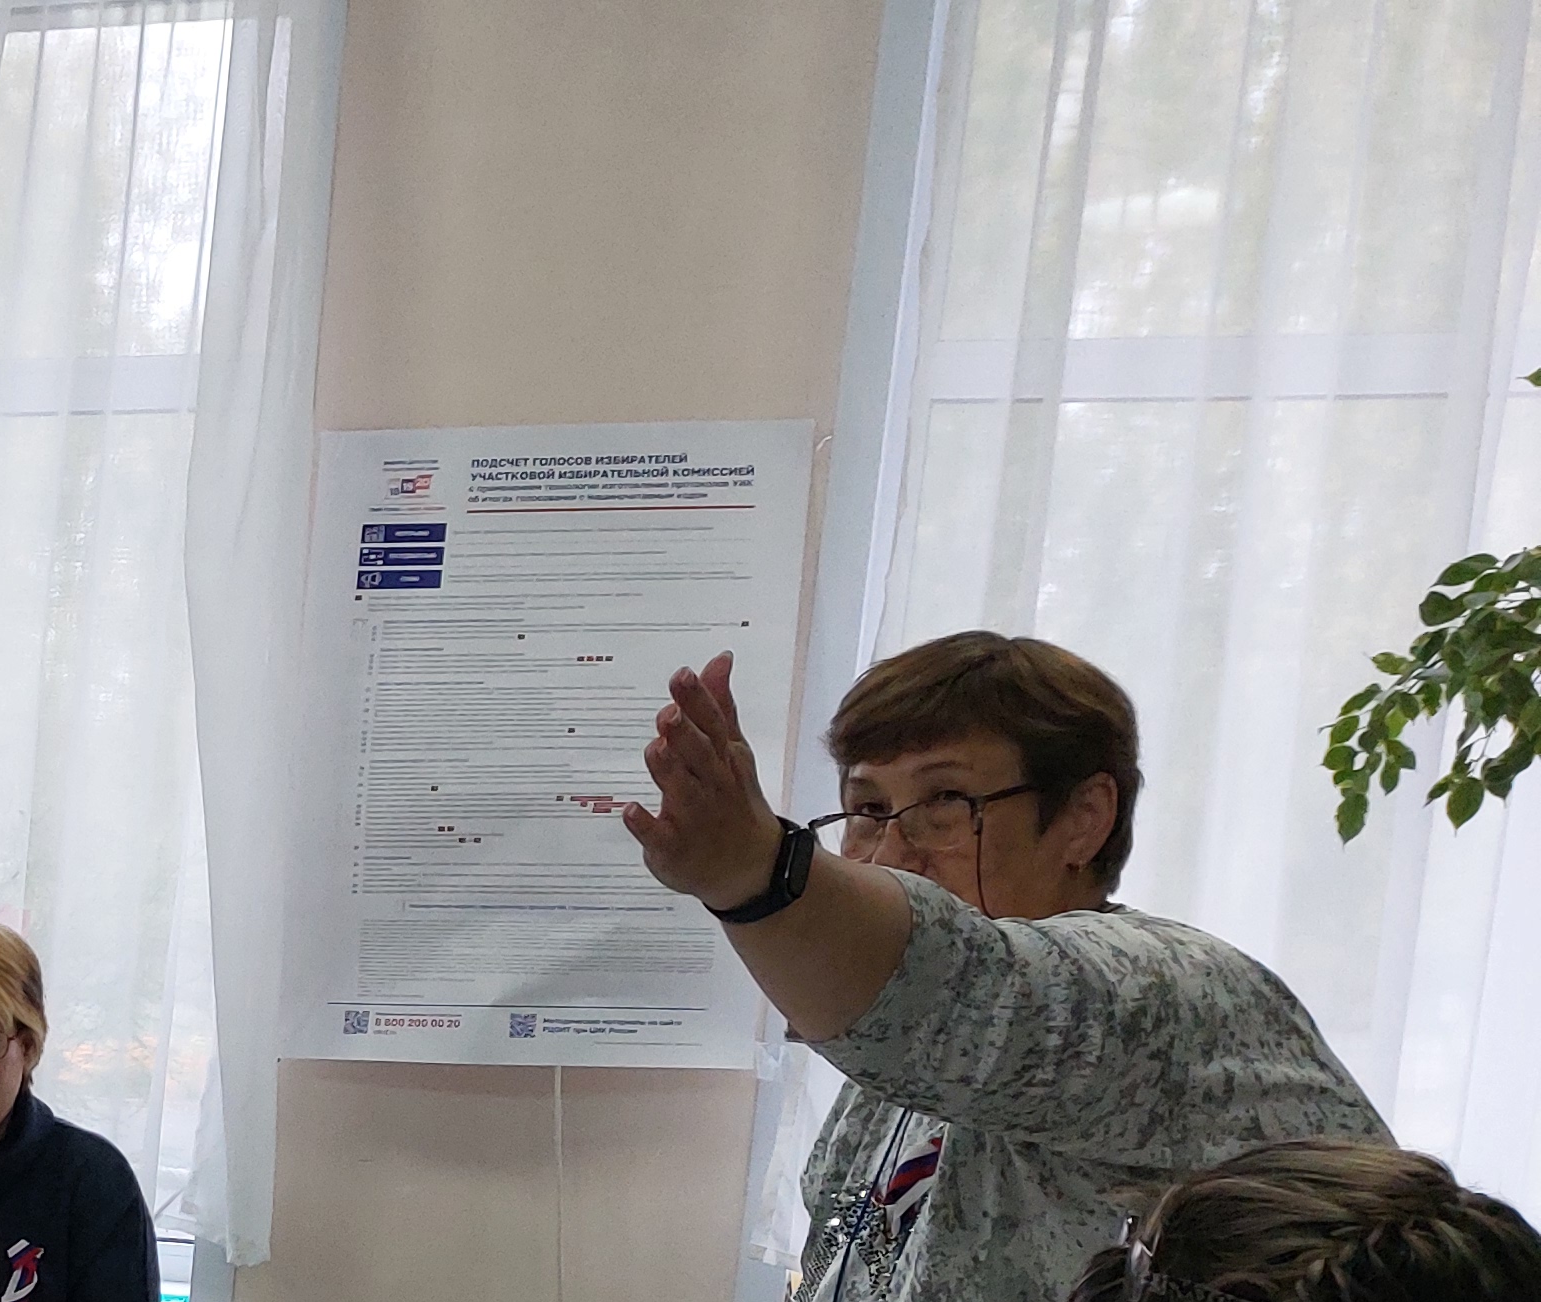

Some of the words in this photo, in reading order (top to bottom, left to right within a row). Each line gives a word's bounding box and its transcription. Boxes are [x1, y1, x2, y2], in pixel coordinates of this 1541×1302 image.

[471, 457, 530, 469] ПОДСЧЕТ
[532, 456, 592, 467] ГОЛОСОВ
[595, 452, 688, 465] ИЗБИРАТЕЛЕЙ
[470, 469, 555, 481] УЧАСТКОВОЙ
[558, 466, 669, 480] ИЗБИРАТЕЛЬНОЙ
[672, 465, 755, 478] КОМИССИЕЙ
[408, 1018, 428, 1027] 200
[446, 1019, 460, 1028] 20
